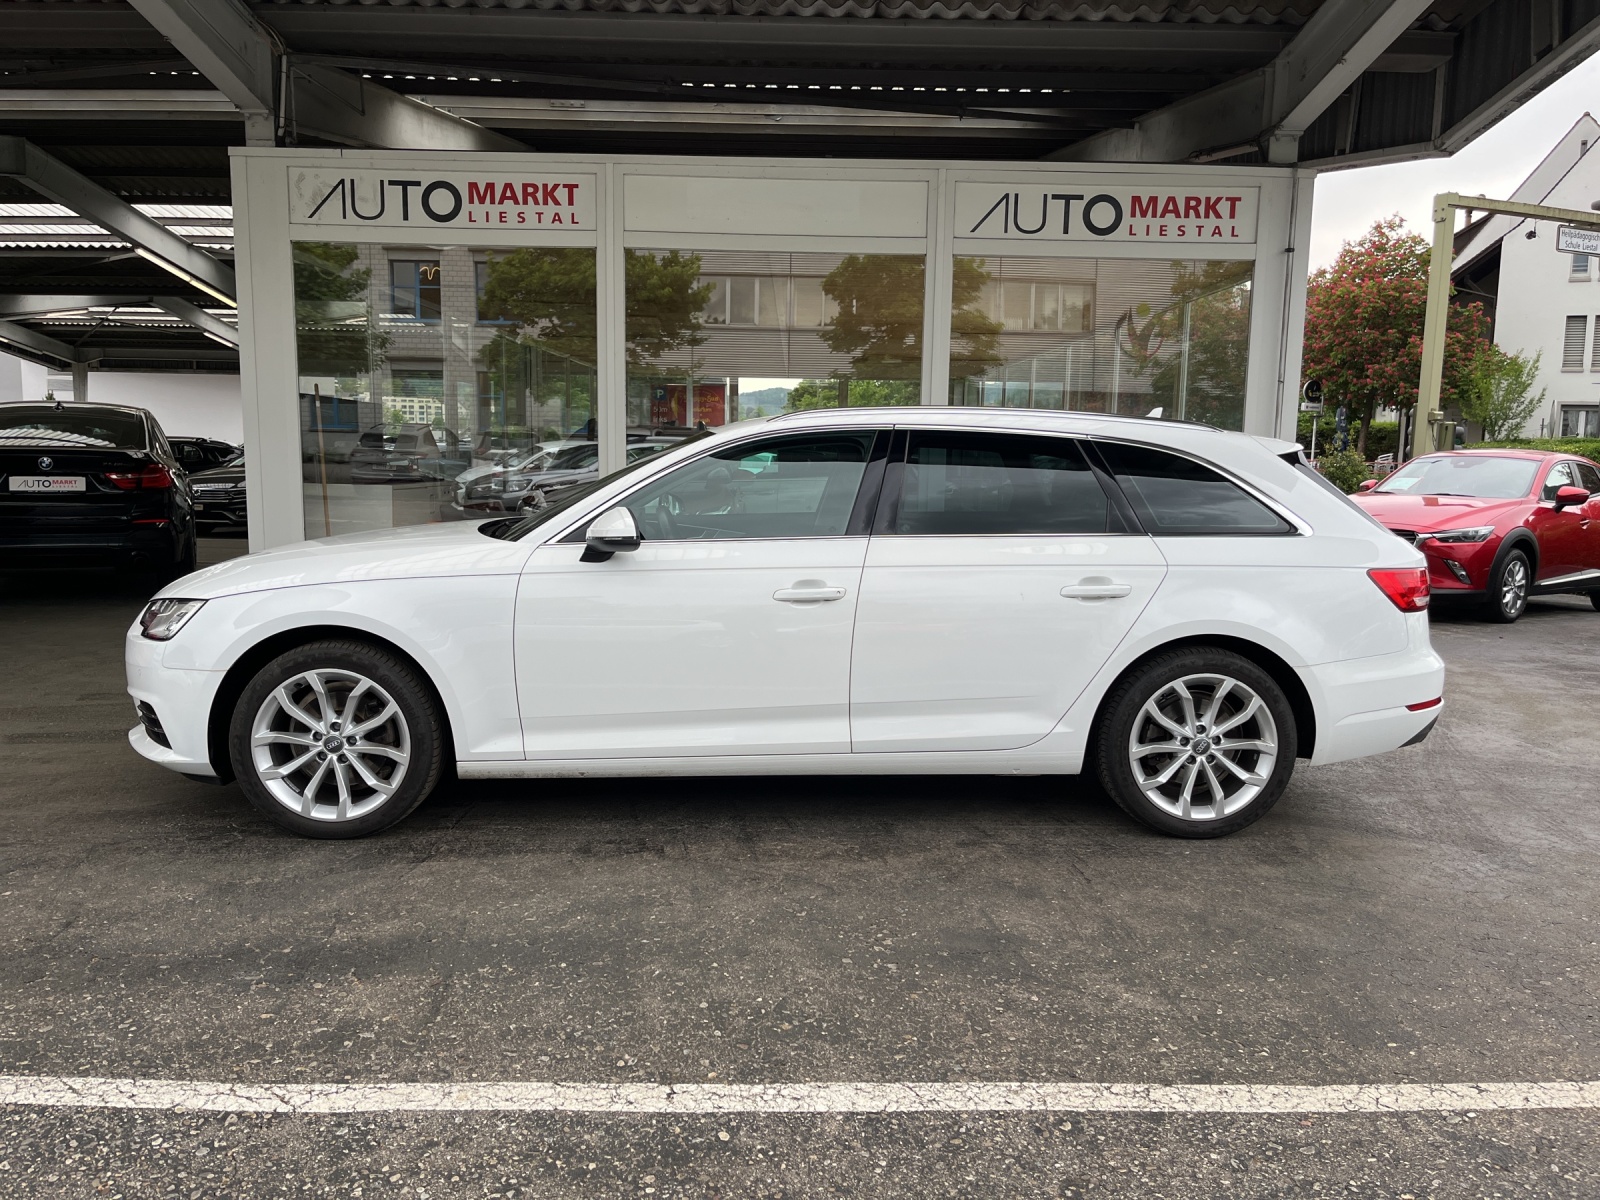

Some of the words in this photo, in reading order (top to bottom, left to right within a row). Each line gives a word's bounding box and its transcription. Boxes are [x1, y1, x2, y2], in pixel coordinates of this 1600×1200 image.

[307, 178, 463, 223] AUTO
[467, 181, 579, 206] MARKT
[468, 211, 579, 224] LIESTAL
[969, 192, 1123, 236] AUTO
[1129, 195, 1242, 219] MARKT
[1128, 224, 1239, 237] LIESTAL
[1564, 240, 1581, 250] Schule
[1582, 242, 1598, 252] Liestal
[656, 389, 664, 399] P
[17, 479, 52, 488] AUTO
